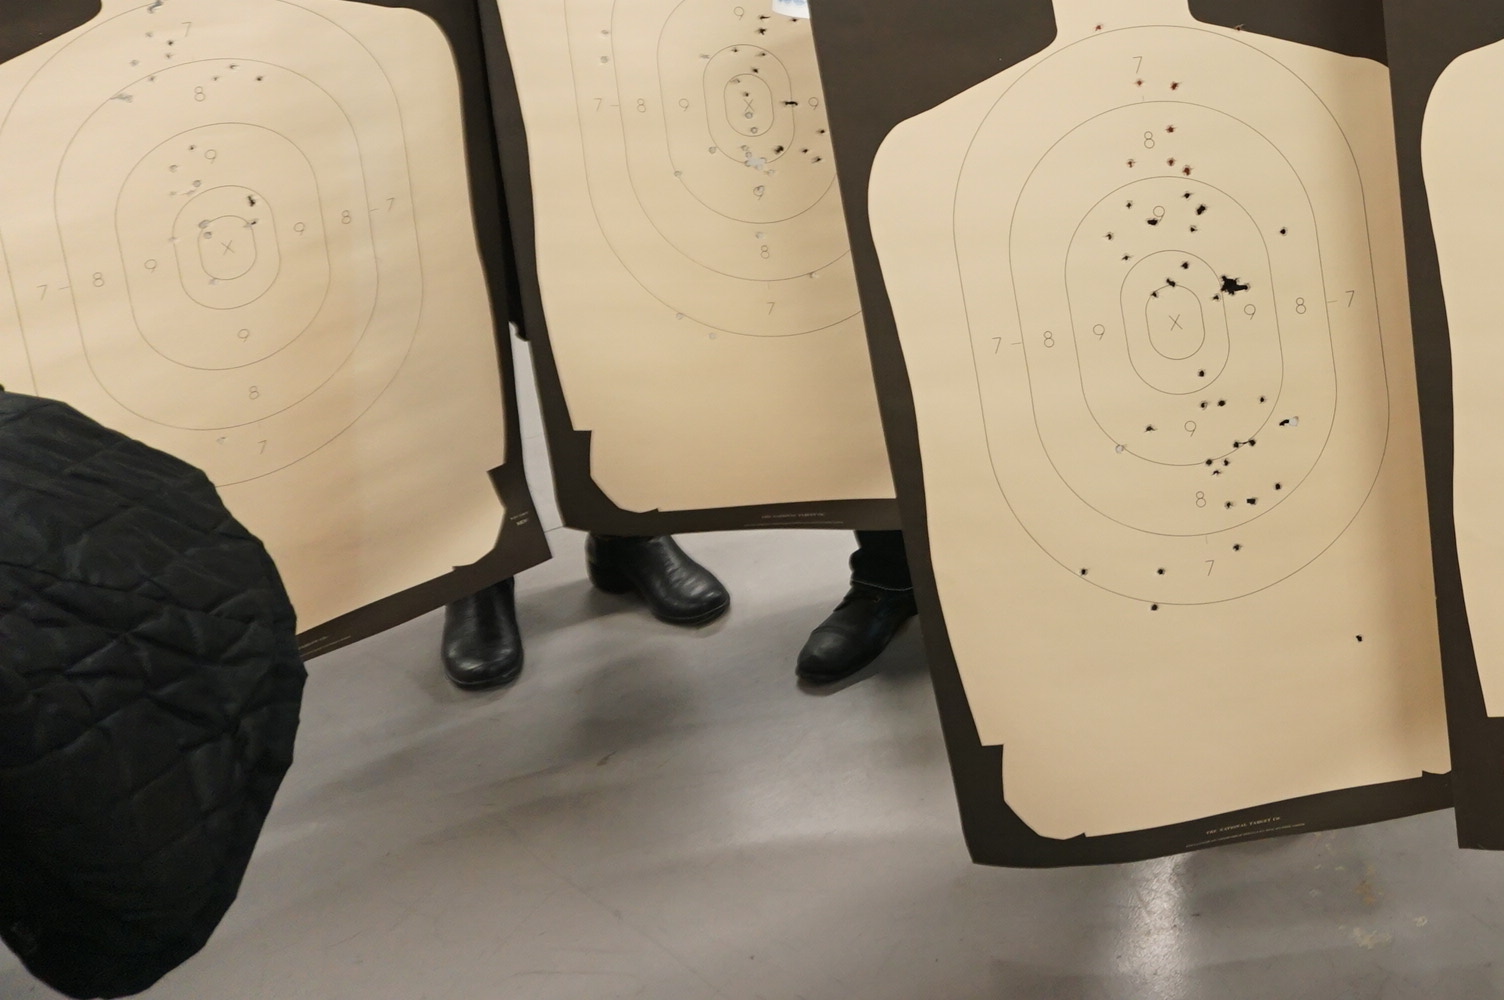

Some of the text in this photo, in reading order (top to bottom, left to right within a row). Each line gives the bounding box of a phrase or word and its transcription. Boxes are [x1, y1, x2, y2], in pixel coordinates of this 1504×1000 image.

[733, 5, 745, 22] 9
[181, 21, 194, 38] 7
[1132, 55, 1144, 74] 7
[193, 86, 206, 103] 8
[594, 97, 603, 112] 7
[636, 97, 647, 113] 8
[678, 97, 690, 112] 9
[744, 98, 755, 114] X
[807, 96, 820, 111] 9
[1143, 130, 1156, 150] 8
[204, 148, 218, 164] 9
[386, 197, 396, 212] 7
[340, 209, 353, 226] 8
[1152, 205, 1166, 223] 9
[293, 221, 306, 237] 9
[220, 240, 236, 255] X
[759, 244, 771, 260] 8
[144, 258, 158, 274] 9
[92, 271, 105, 288] 8
[36, 284, 48, 301] 7
[1344, 290, 1356, 309] 7
[766, 301, 776, 316] 7
[1243, 303, 1257, 321] 9
[1295, 296, 1307, 315] 8
[1168, 313, 1184, 331] X
[236, 328, 250, 343] 9
[1042, 330, 1055, 348] 8
[1092, 323, 1106, 341] 9
[991, 336, 1003, 355] 7
[248, 385, 260, 400] 8
[1183, 420, 1197, 437] 9
[257, 439, 268, 455] 7
[1195, 490, 1207, 509] 8
[1204, 559, 1215, 577] 7
